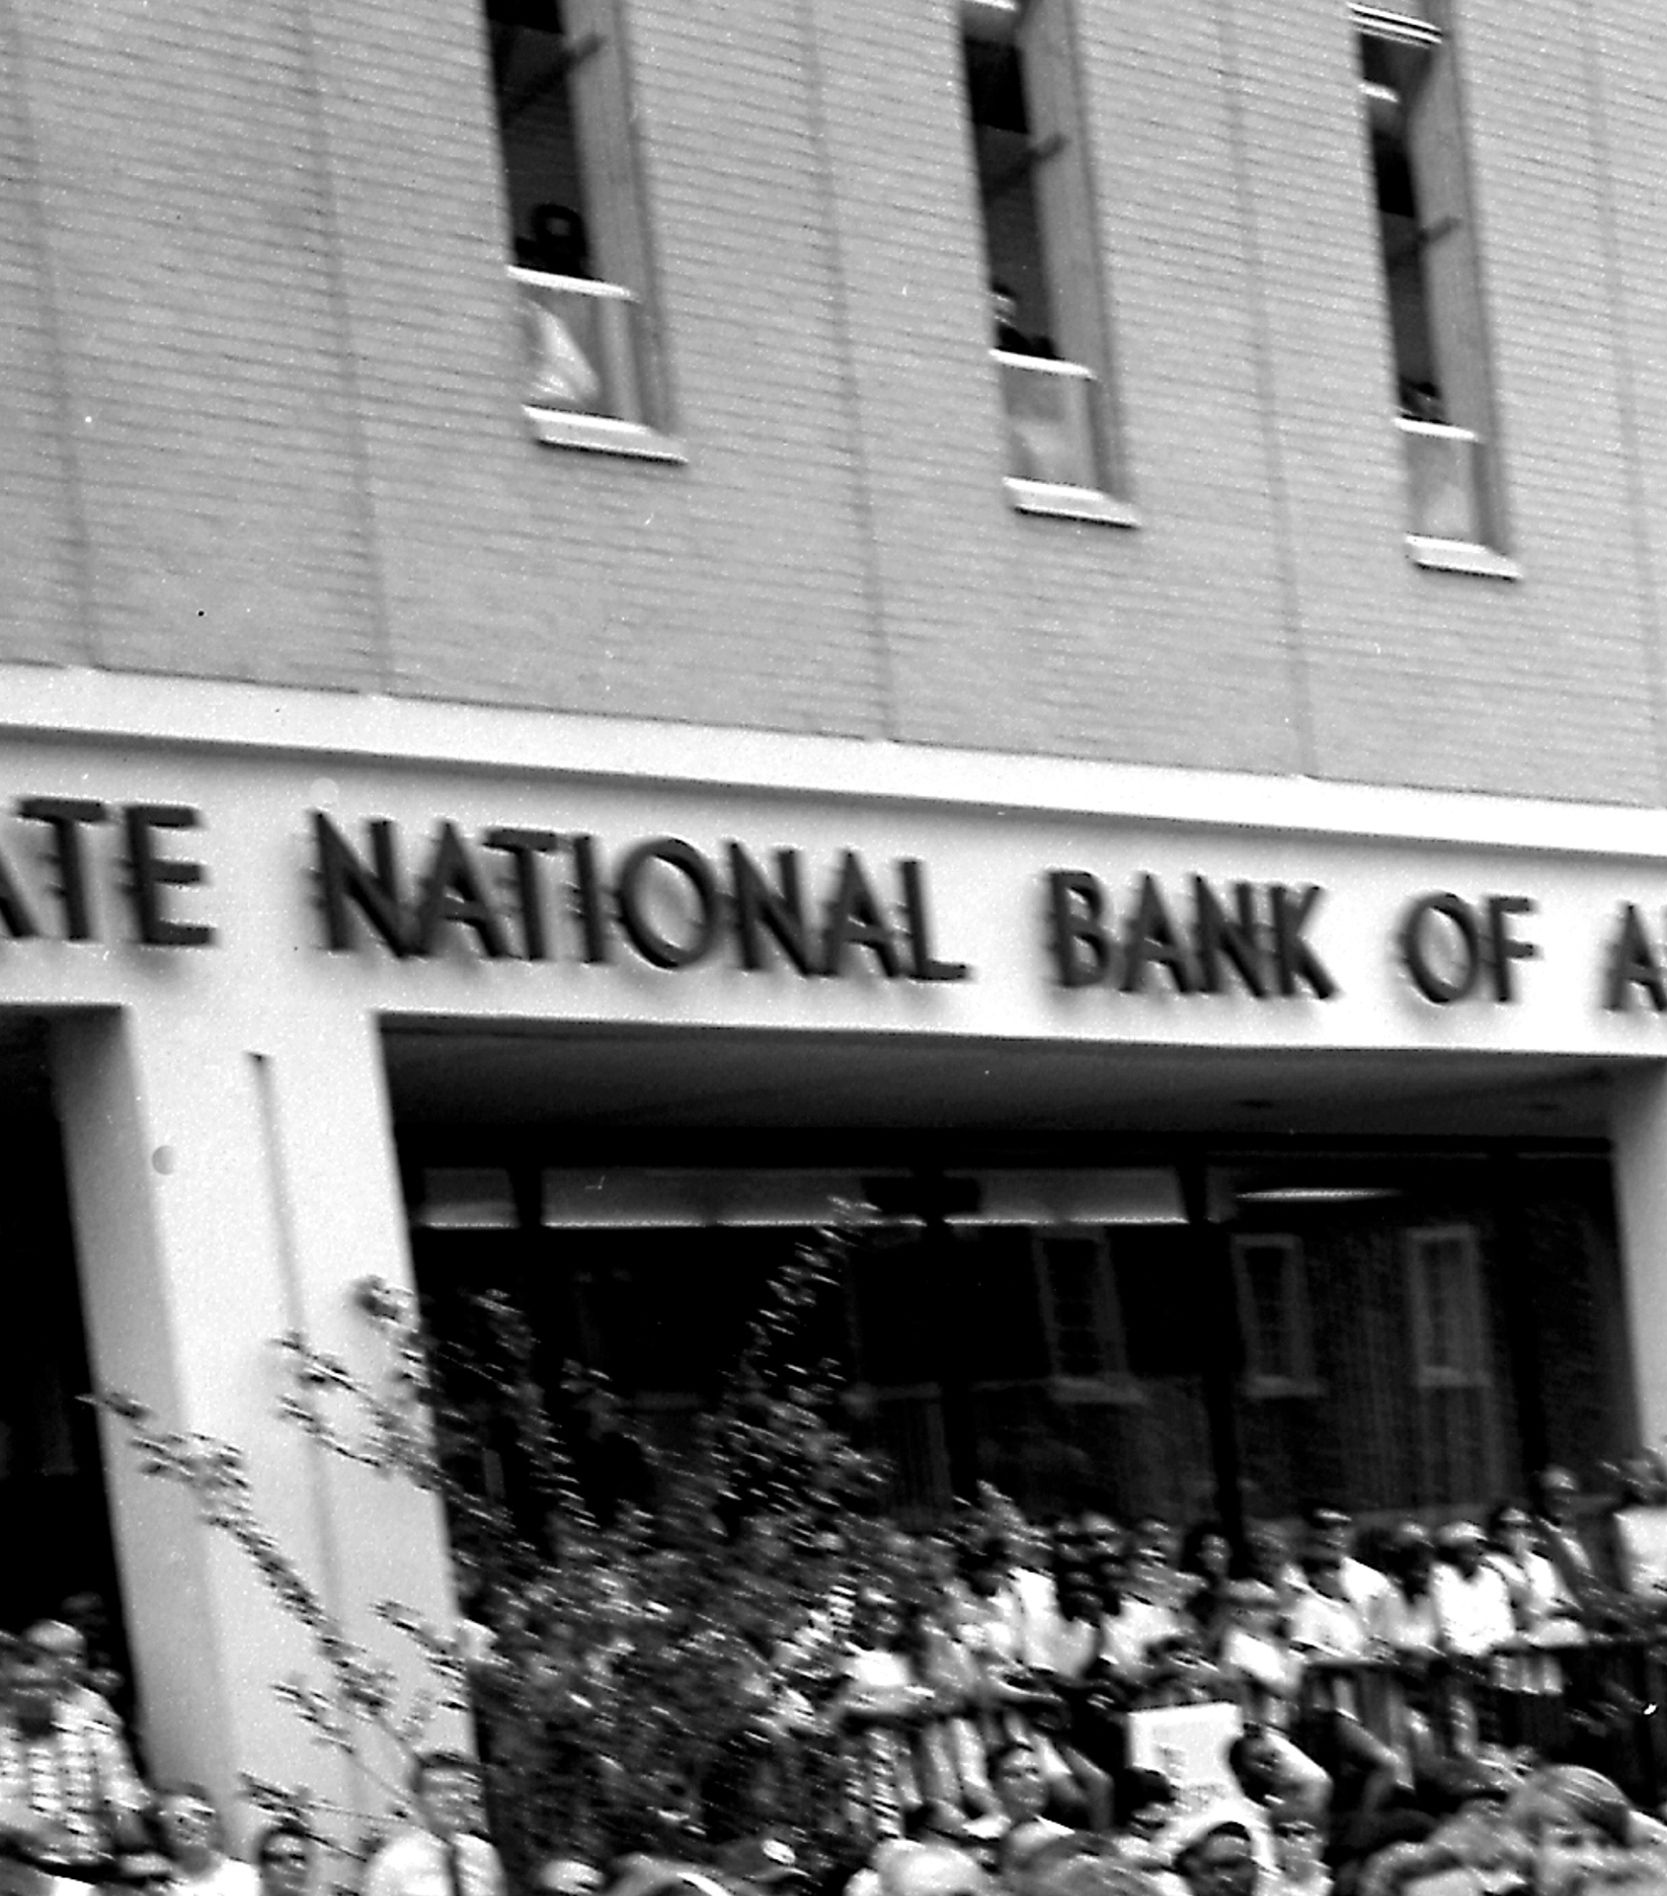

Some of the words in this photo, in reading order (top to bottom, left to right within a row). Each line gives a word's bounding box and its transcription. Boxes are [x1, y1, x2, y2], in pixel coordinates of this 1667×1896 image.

[308, 809, 968, 983] NATIONAL
[1045, 870, 1336, 1001] BANK
[1398, 892, 1536, 1005] OF
